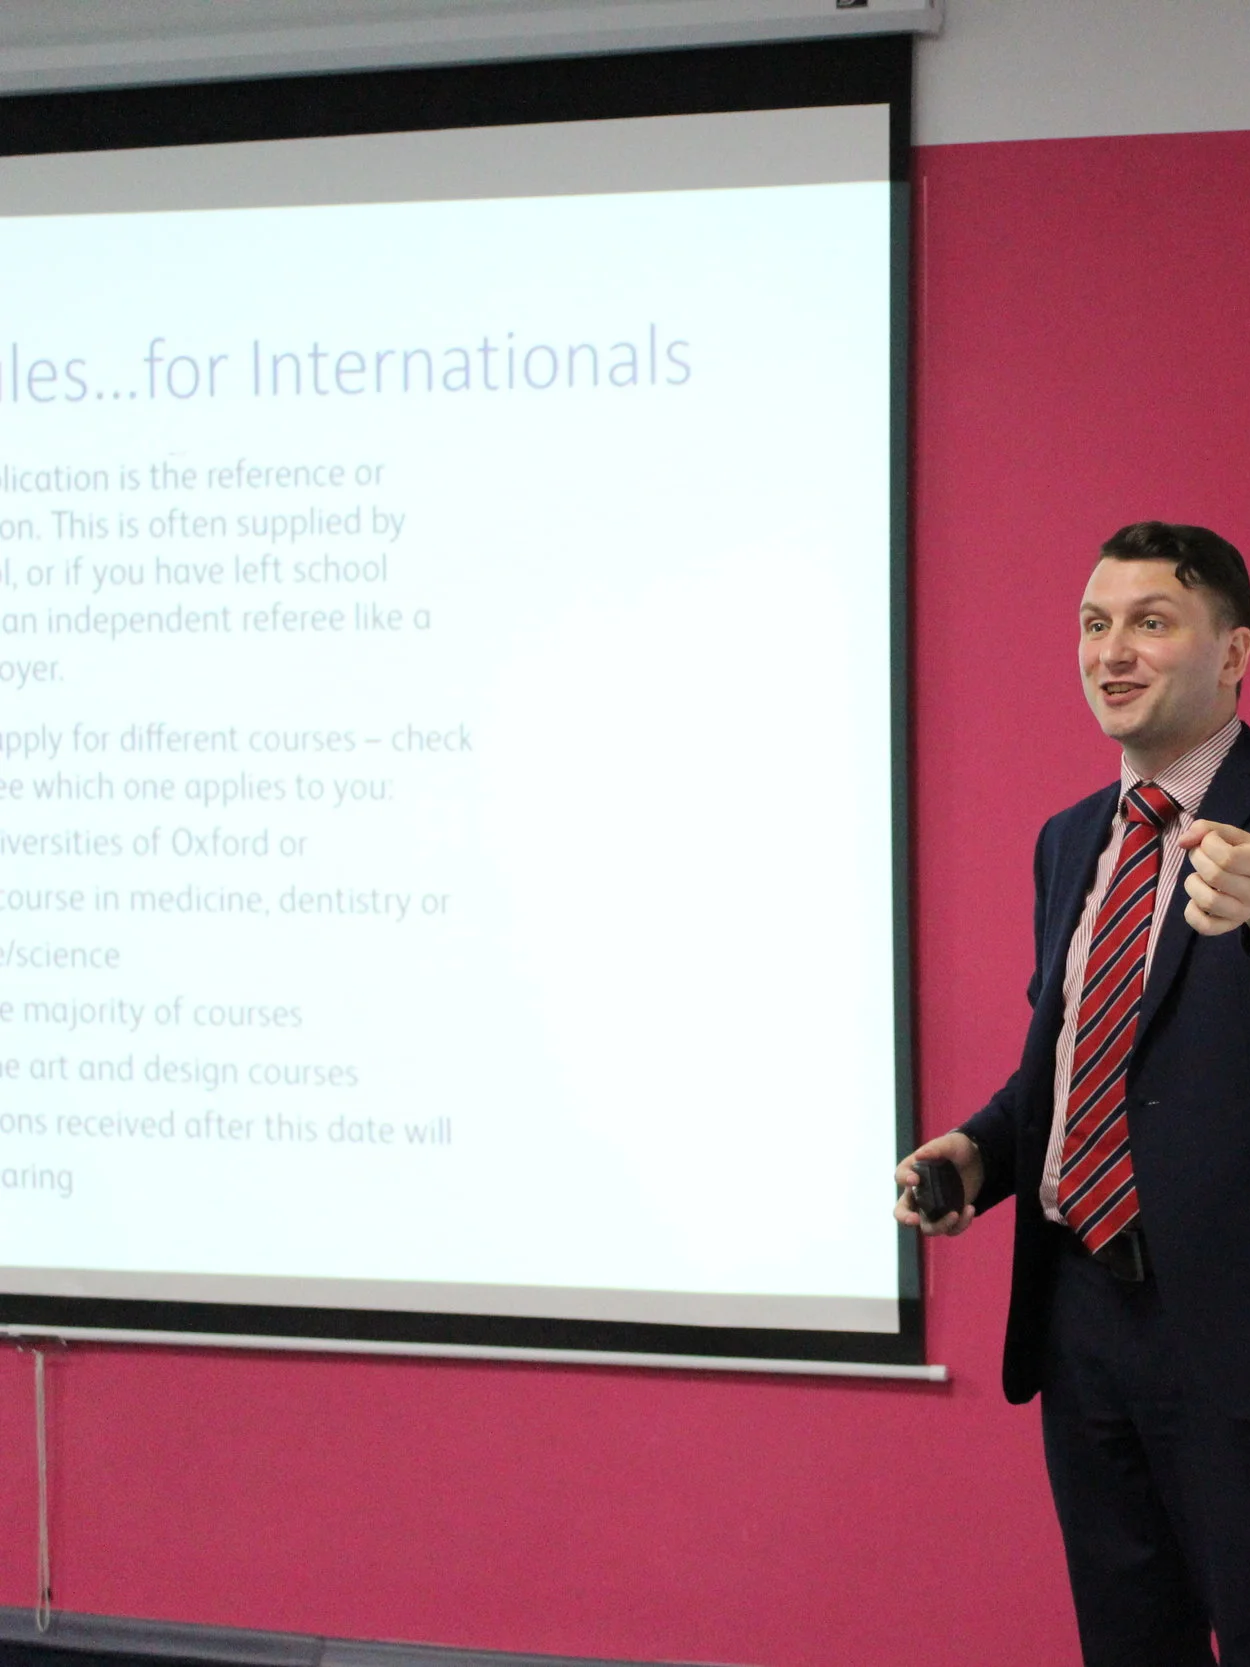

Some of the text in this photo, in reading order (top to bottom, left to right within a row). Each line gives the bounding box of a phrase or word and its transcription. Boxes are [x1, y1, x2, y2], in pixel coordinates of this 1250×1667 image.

[0, 322, 692, 404] les...for Internationals
[0, 457, 385, 493] lication is the reference or
[50, 509, 109, 540] This
[118, 512, 139, 539] is
[148, 506, 227, 538] often
[237, 505, 361, 544] supplied
[372, 505, 405, 543] by
[0, 552, 387, 595] l, or if you have left school
[1, 601, 430, 641] an independent referee like a
[0, 723, 62, 760] pply
[72, 721, 110, 753] for
[119, 721, 239, 752] different
[249, 730, 356, 752] courses
[391, 722, 472, 752] check
[32, 770, 114, 800] which
[123, 778, 175, 801] one
[185, 771, 286, 808] applies
[295, 774, 324, 800] to
[333, 779, 392, 808] you:
[132, 825, 161, 857] of
[171, 826, 269, 857] Oxford
[279, 836, 307, 857] or
[95, 887, 119, 911] in
[130, 883, 270, 916] medicine,
[279, 884, 411, 922] dentistry
[421, 893, 450, 915] or
[23, 998, 145, 1032] majority
[154, 995, 184, 1025] of
[193, 1005, 302, 1027] courses
[0, 1052, 358, 1092] e art and design courses
[56, 1109, 174, 1138] received
[184, 1109, 253, 1140] after
[265, 1113, 317, 1142] this
[328, 1114, 394, 1144] date
[404, 1117, 451, 1144] will
